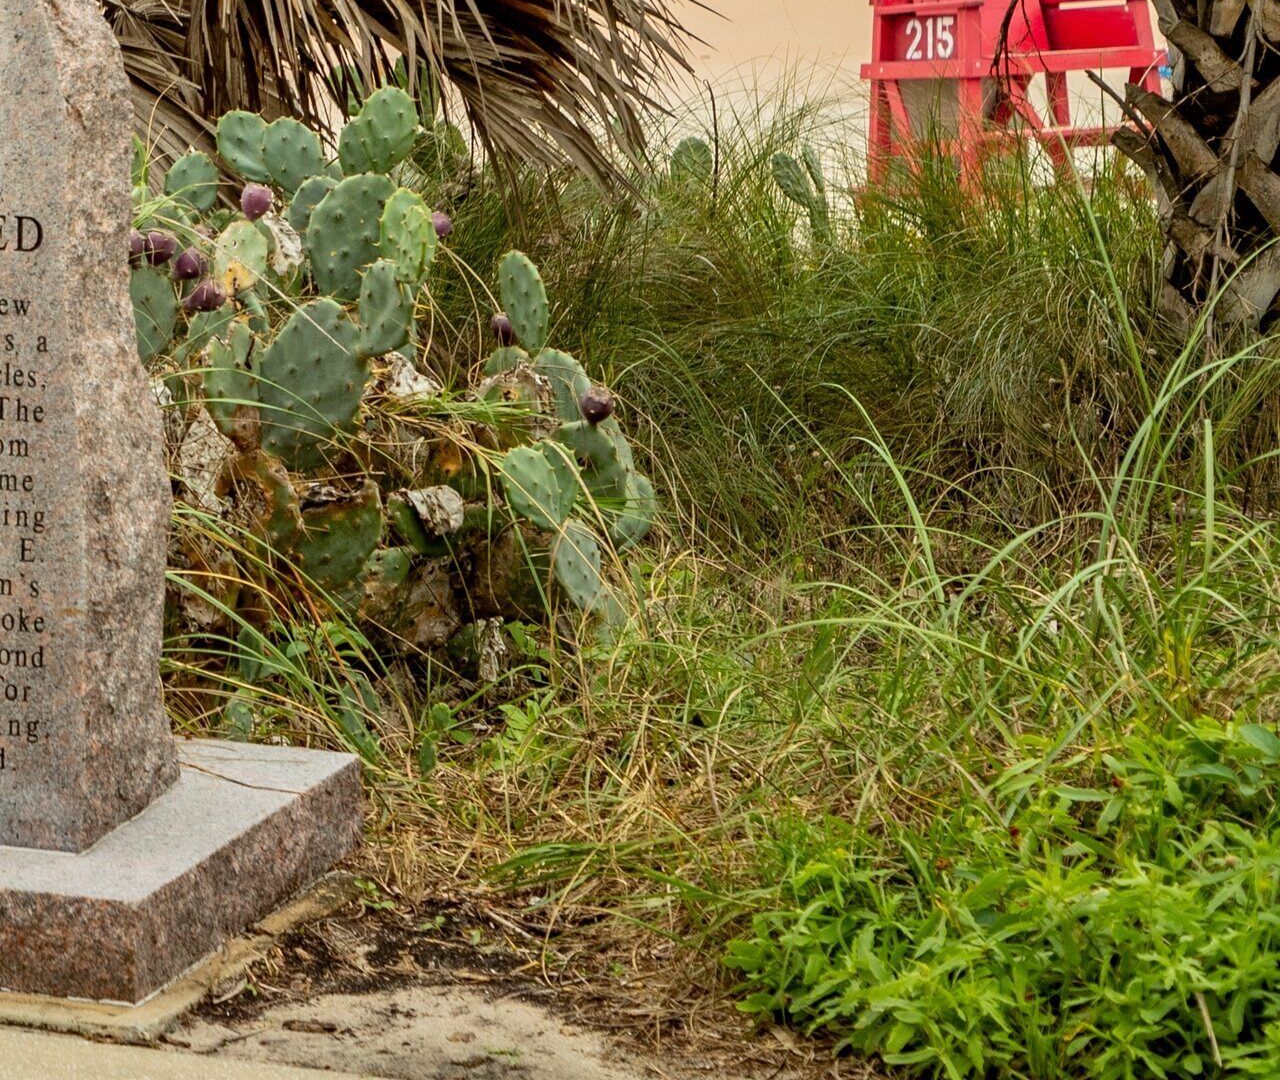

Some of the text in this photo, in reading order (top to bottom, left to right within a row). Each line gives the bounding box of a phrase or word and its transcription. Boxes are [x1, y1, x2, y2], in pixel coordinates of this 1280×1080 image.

[905, 16, 954, 60] 215
[37, 334, 48, 353] a
[20, 538, 44, 563] E.
